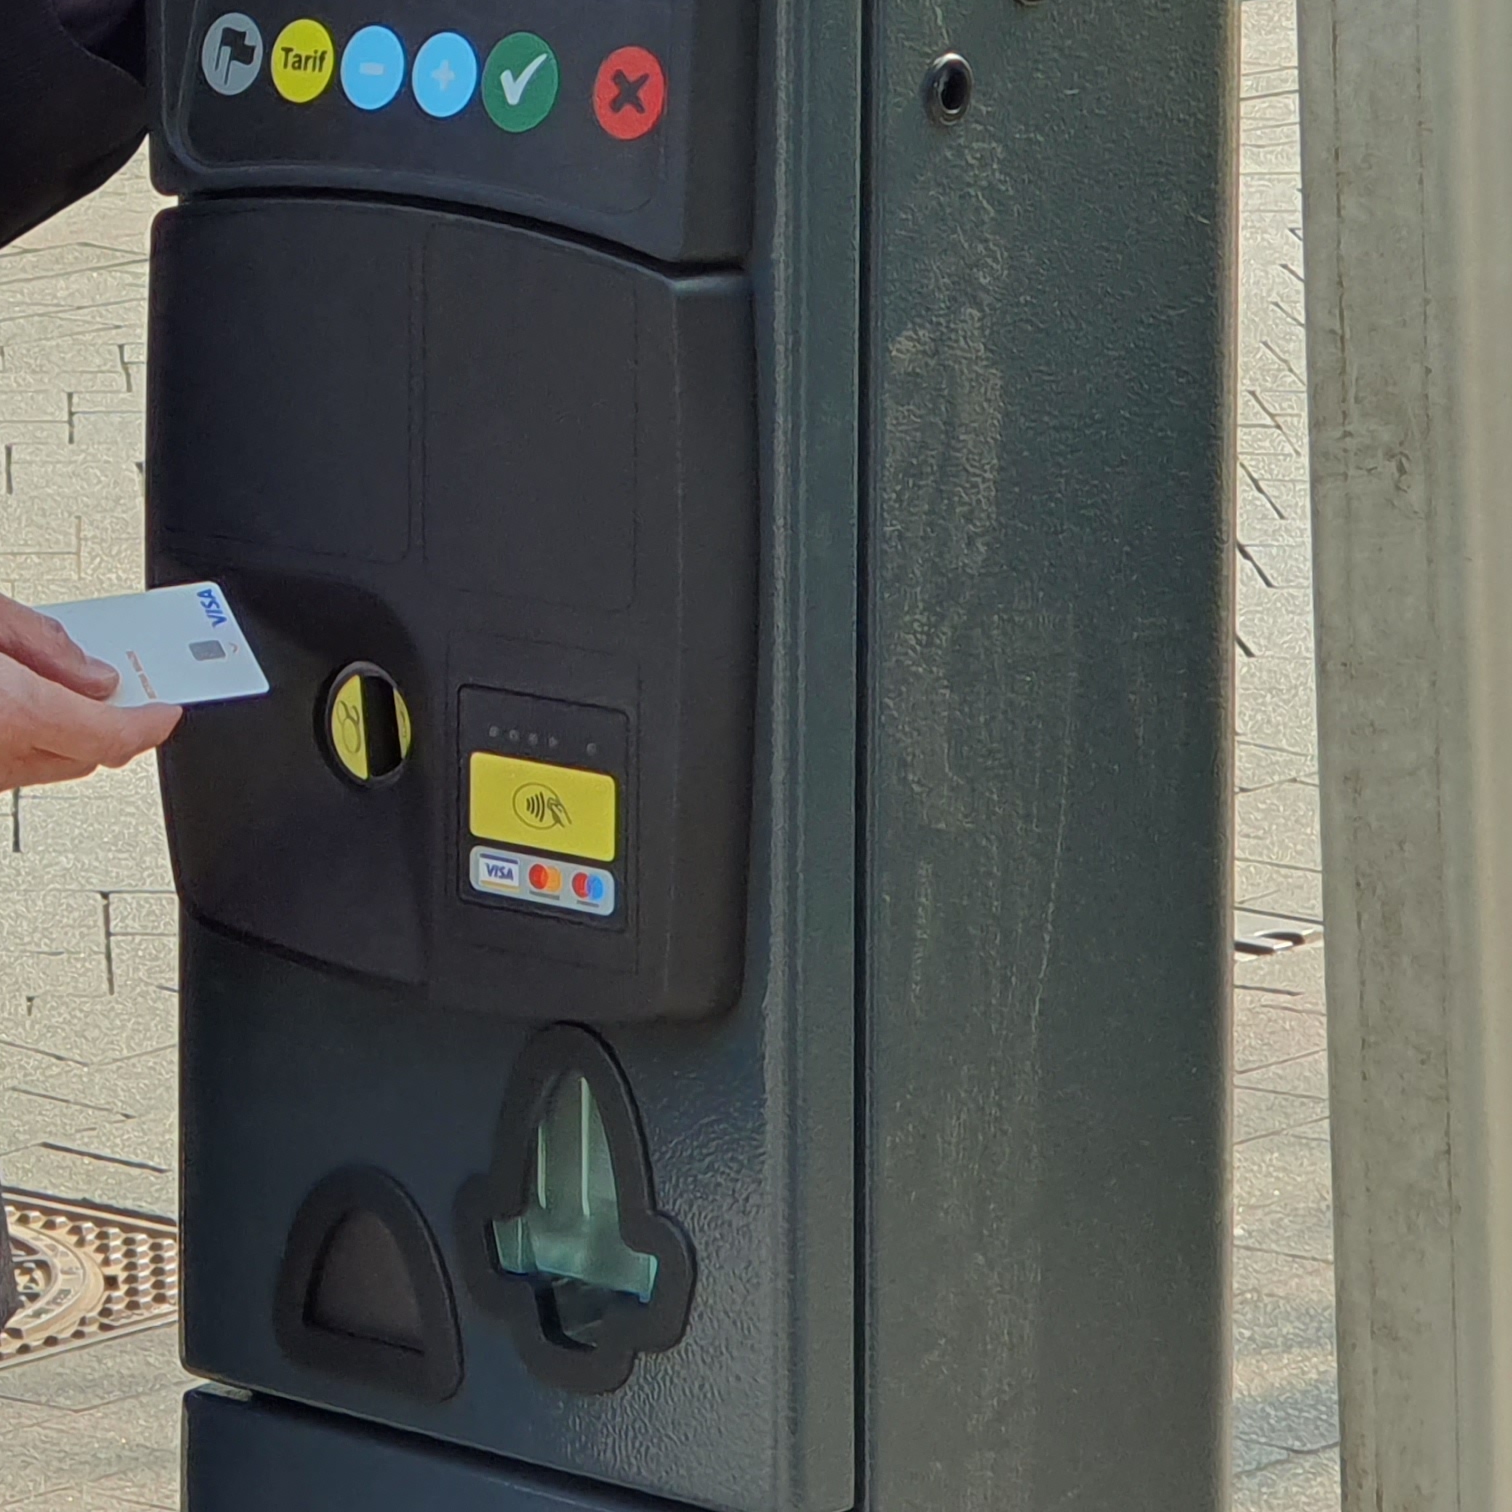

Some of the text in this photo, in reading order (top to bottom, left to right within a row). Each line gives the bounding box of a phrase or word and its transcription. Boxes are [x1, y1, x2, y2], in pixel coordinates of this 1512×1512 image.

[281, 46, 328, 74] Tarif
[197, 589, 227, 629] VISA
[485, 862, 515, 881] VISA
